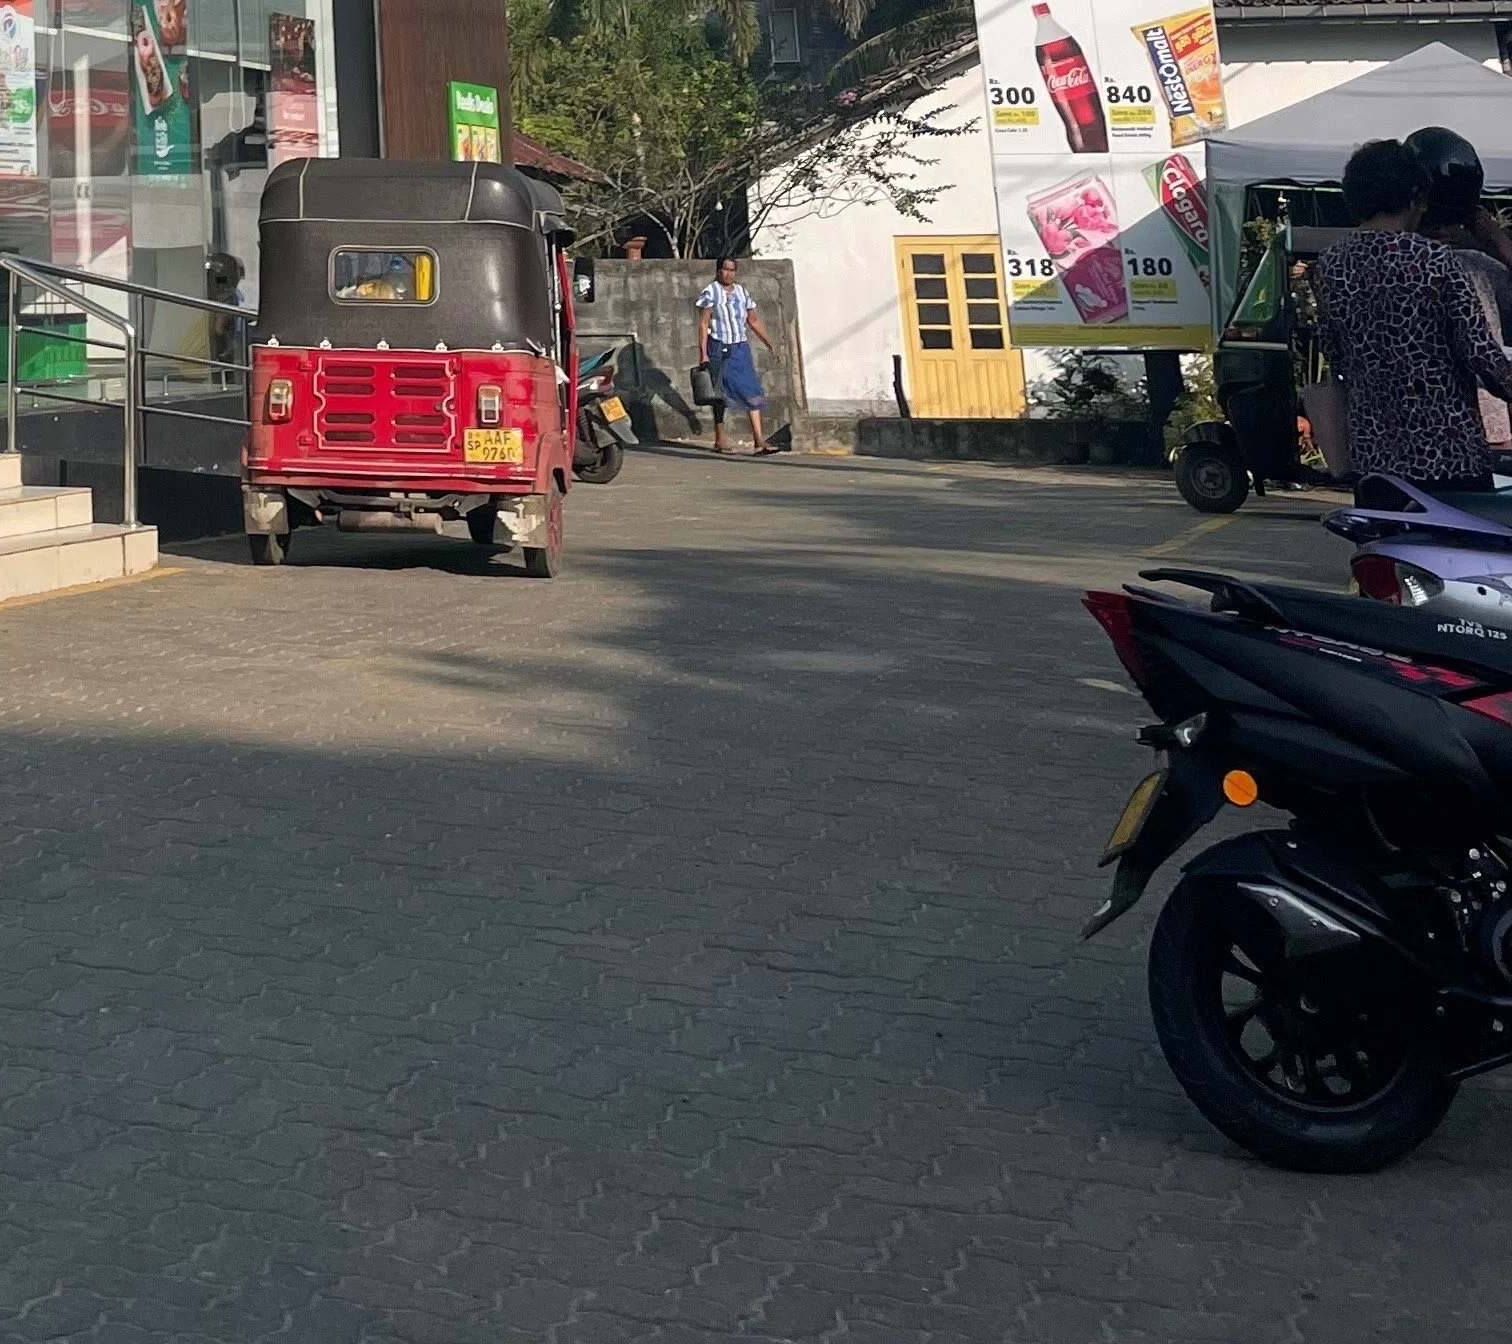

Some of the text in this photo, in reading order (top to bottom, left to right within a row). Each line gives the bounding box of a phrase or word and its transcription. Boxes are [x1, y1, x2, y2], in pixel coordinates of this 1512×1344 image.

[990, 87, 1035, 105] 300
[1106, 85, 1152, 103] 840
[1008, 258, 1054, 277] 318
[1127, 257, 1173, 276] 180
[467, 440, 481, 450] SP
[484, 431, 511, 445] AAF
[1437, 623, 1508, 640] NTORQ 125
